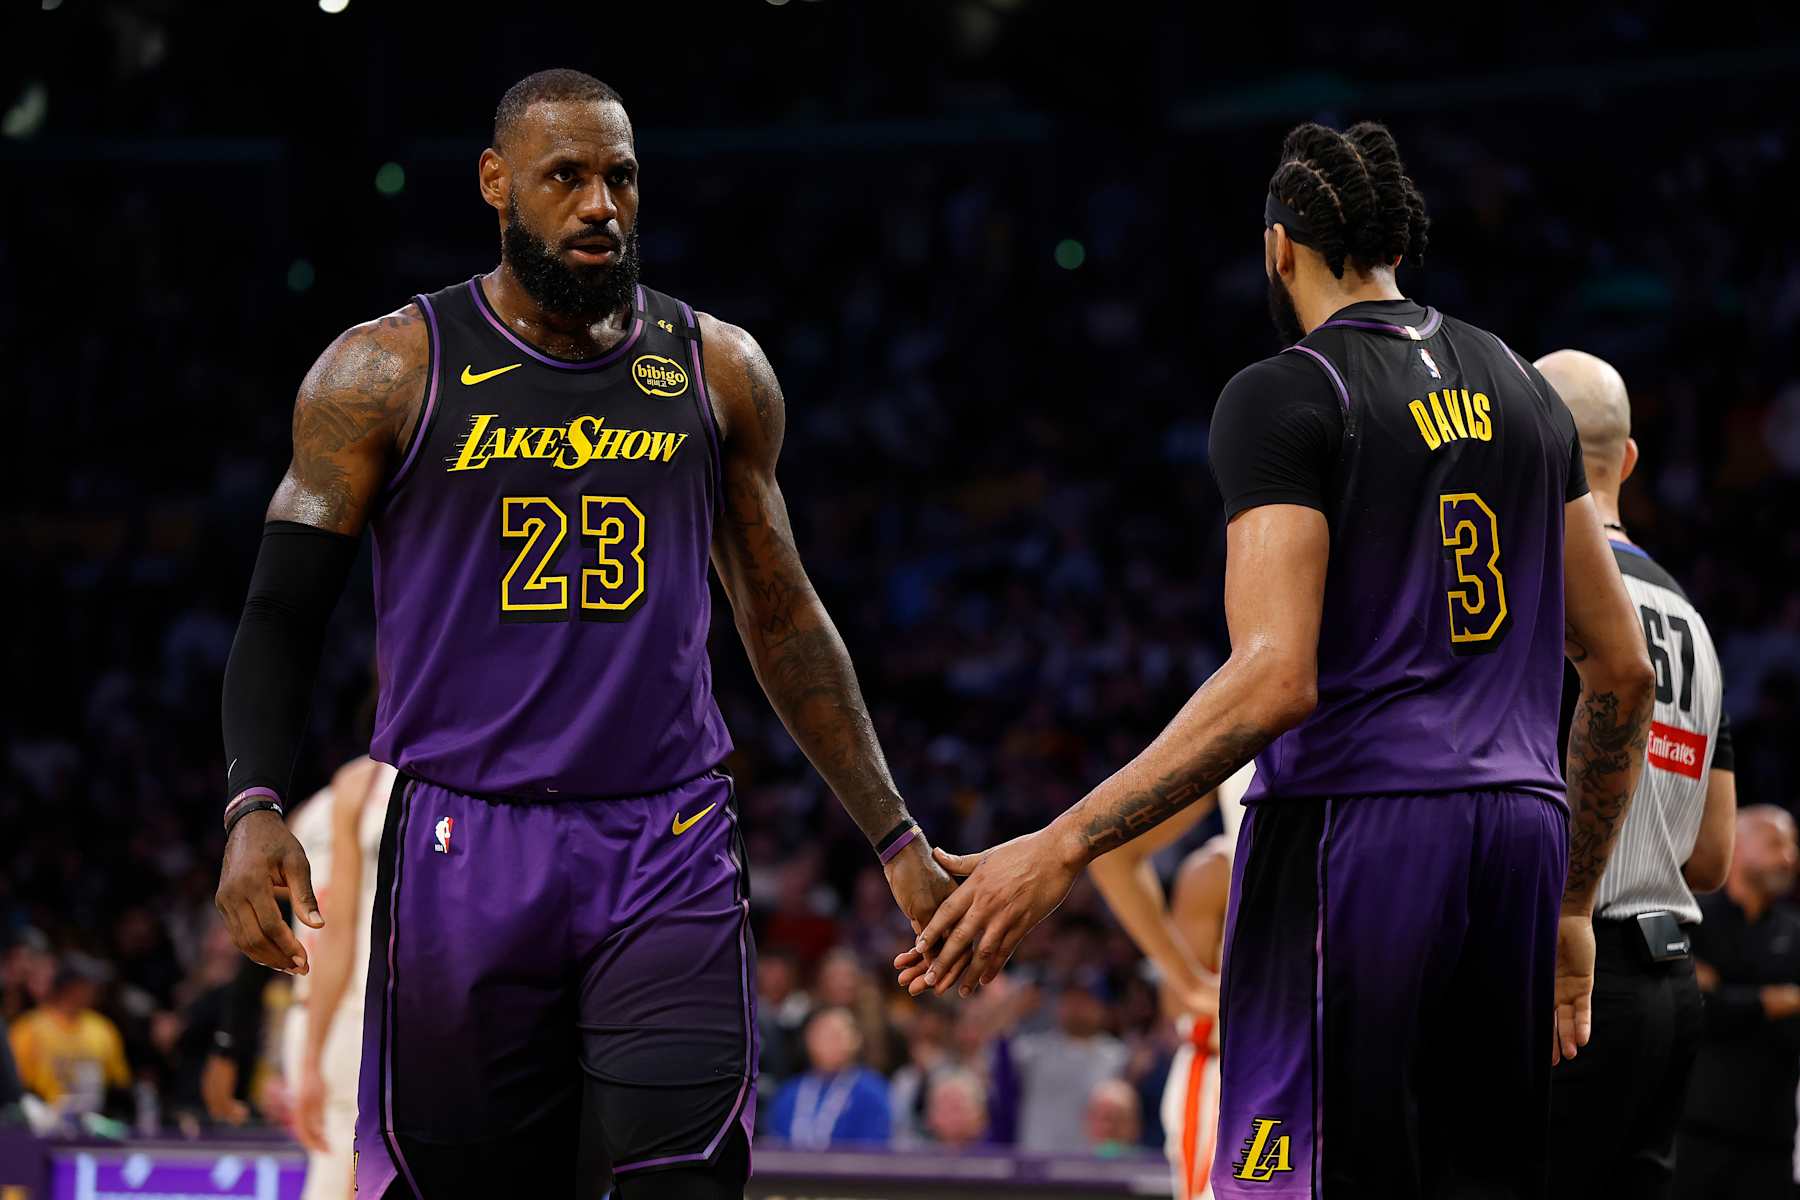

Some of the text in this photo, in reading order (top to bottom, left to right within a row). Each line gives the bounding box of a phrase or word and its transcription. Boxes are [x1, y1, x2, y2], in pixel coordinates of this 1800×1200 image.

[637, 364, 684, 386] bibigo
[1408, 389, 1493, 451] DAVIS
[502, 495, 645, 612] 23
[1440, 493, 1507, 643] 3
[1640, 604, 1694, 712] 67
[1232, 1118, 1293, 1181] LA
